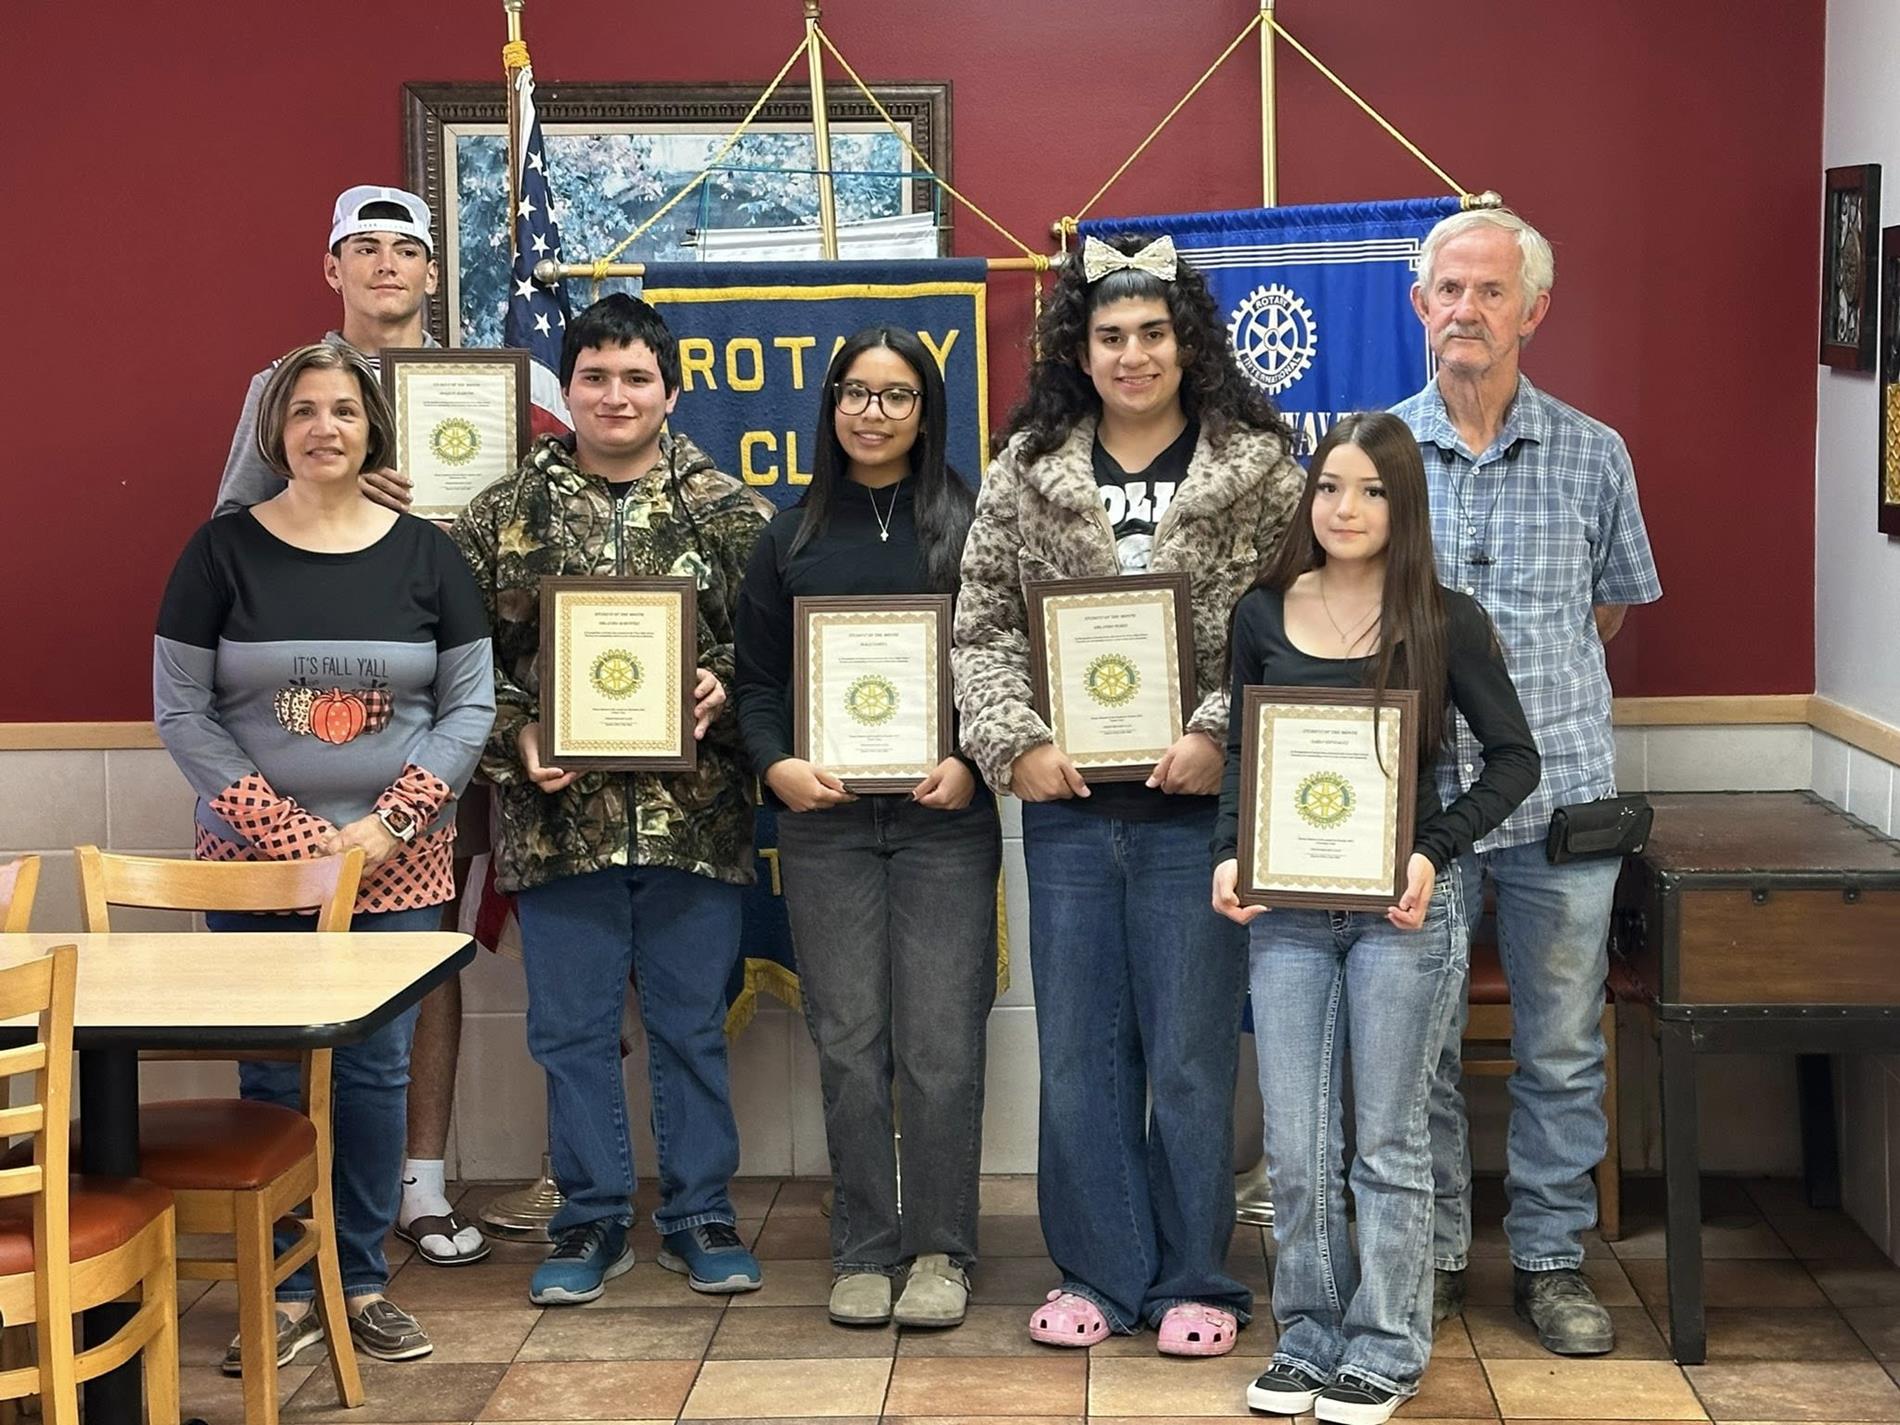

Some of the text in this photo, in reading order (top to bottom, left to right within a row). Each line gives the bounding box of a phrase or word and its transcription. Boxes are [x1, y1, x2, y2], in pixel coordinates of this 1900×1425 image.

[1256, 296, 1288, 309] ROTARY
[678, 329, 960, 392] ROTY
[1241, 356, 1302, 384] INTERNATIONAL
[740, 431, 813, 486] CL
[294, 656, 389, 678] IT'S FALL Y'ALL
